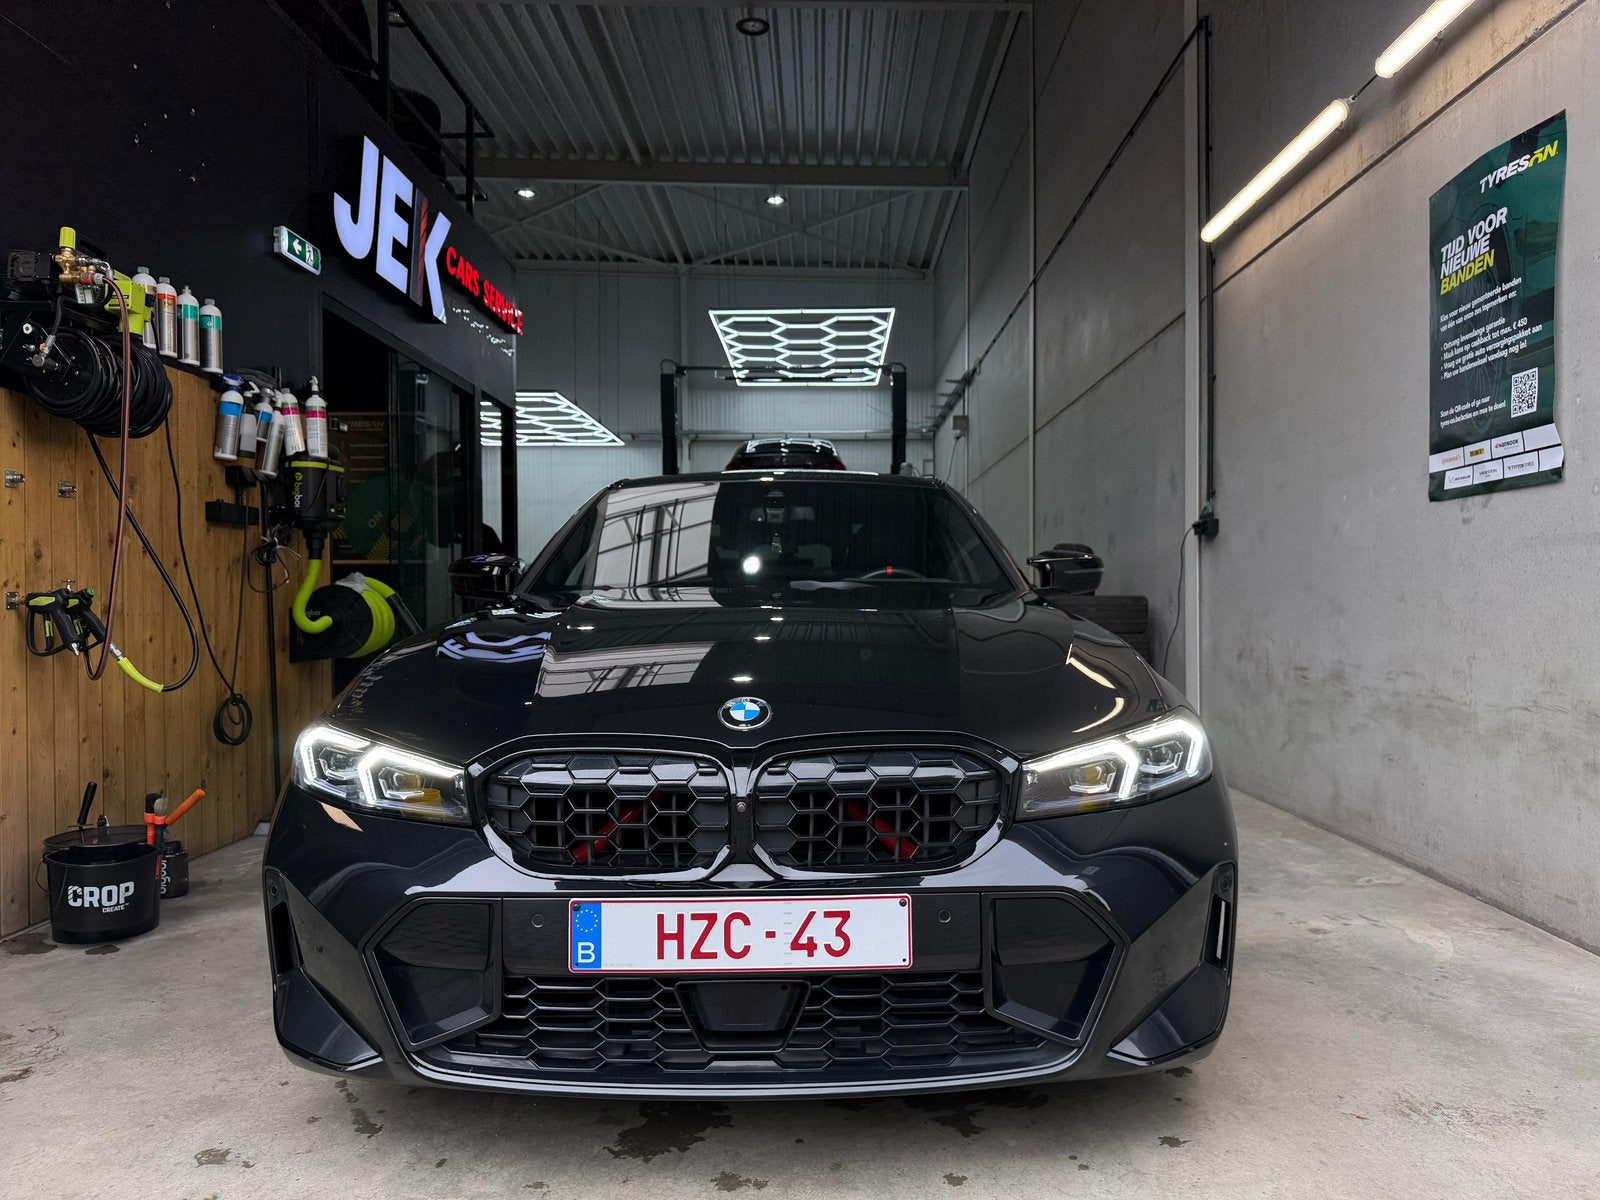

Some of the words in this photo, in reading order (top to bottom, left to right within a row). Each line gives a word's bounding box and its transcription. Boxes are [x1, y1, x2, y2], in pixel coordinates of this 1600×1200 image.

[334, 135, 452, 324] JEK
[1467, 206, 1508, 239] VOOR
[1440, 234, 1490, 279] NIEUWE
[1440, 249, 1494, 295] BANDEN
[446, 246, 480, 297] CARS
[483, 280, 523, 335] SERVICE
[1459, 303, 1470, 313] nieuw
[1471, 287, 1501, 309] gemonteerde
[1502, 278, 1521, 291] banden
[1482, 295, 1507, 311] topmerken
[1460, 326, 1484, 342] levenslange
[1485, 315, 1505, 332] garantie
[1461, 350, 1474, 364] gratis
[1475, 346, 1484, 356] auto
[1486, 325, 1530, 351] verzorgingspakket
[1531, 324, 1542, 332] aan
[1464, 343, 1470, 351] op
[1471, 332, 1490, 347] cashback
[1500, 326, 1512, 335] max.
[1512, 321, 1516, 329] €
[1517, 317, 1527, 327] 450
[1443, 371, 1451, 379] Plan
[1459, 355, 1487, 373] bandenwissel
[1488, 348, 1507, 361] vandaag
[1508, 344, 1518, 353] nog
[1454, 402, 1470, 412] QR-code
[292, 481, 303, 508] bigboi
[306, 609, 321, 618] gboi
[67, 881, 135, 908] CROP
[577, 941, 596, 963] B
